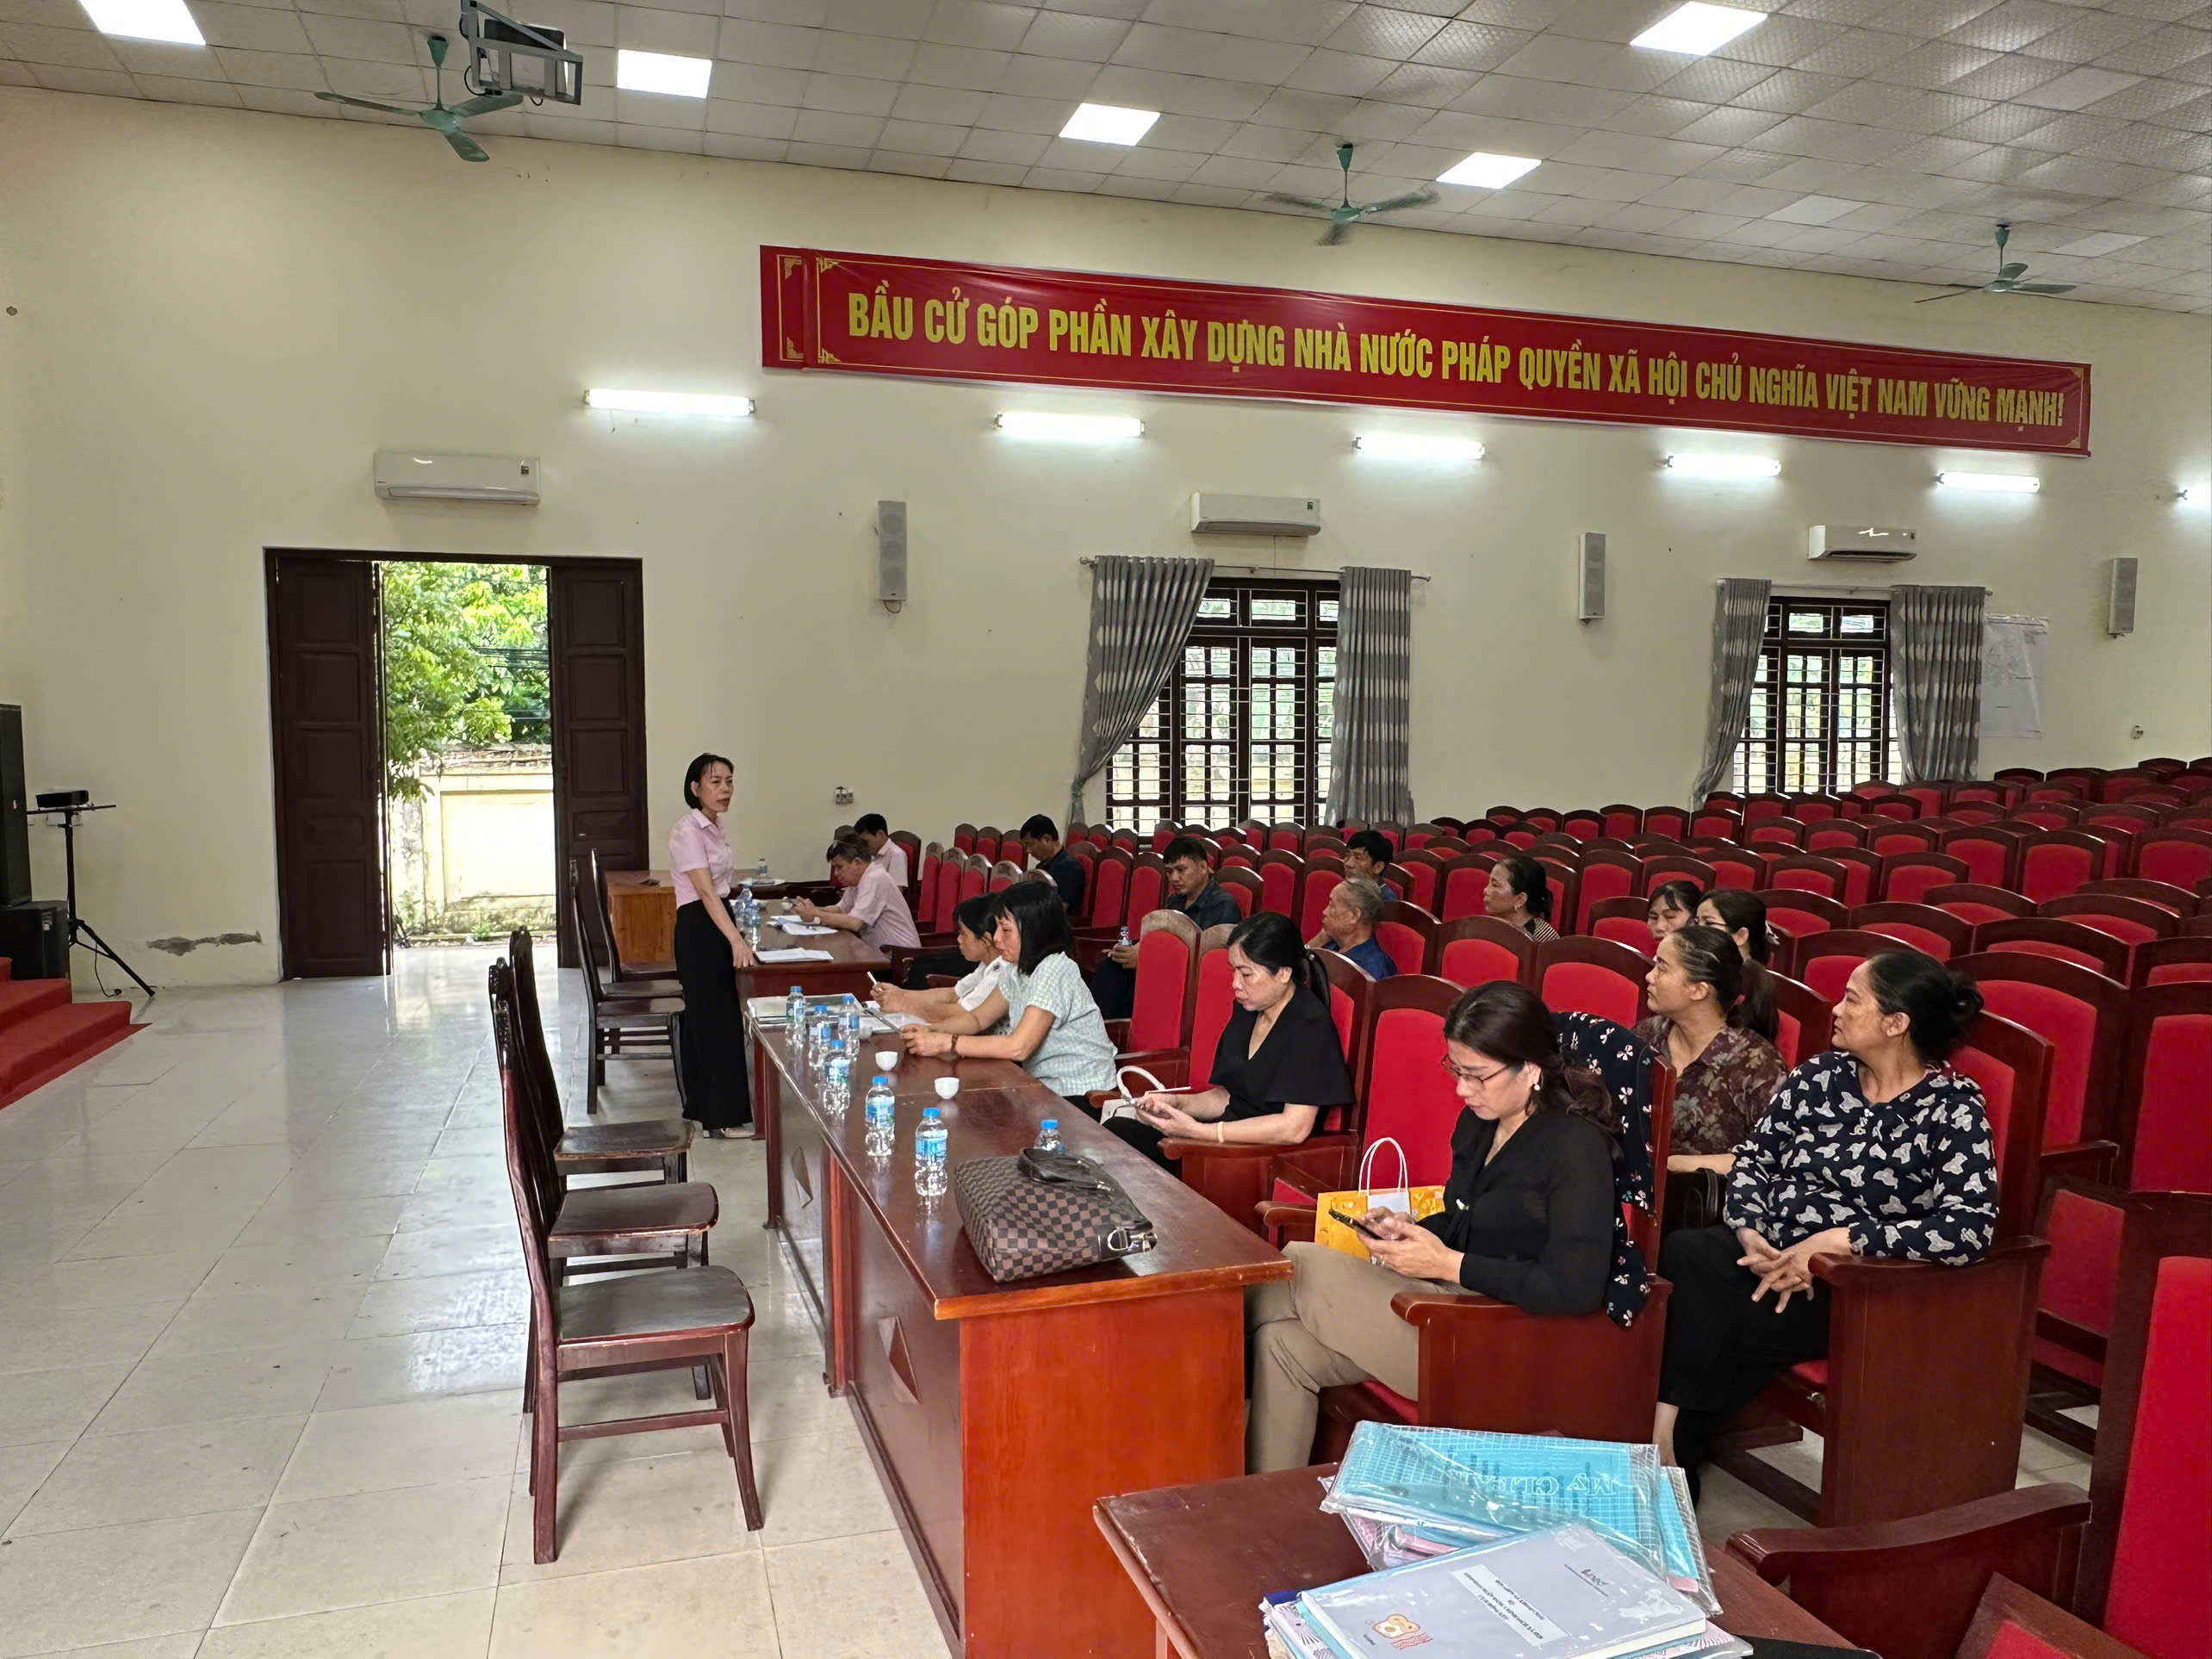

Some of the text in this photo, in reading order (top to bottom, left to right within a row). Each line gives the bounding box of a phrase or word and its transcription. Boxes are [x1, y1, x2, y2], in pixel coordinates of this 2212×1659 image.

[848, 279, 2065, 431] BẦU CỬ GÓP PHẦN XÂY DỰNG NHÀ NƯỚC PHÁP QUYỀN XÃ HỘI CHỦ NGHĨA VIỆT NAM VỮNG MẠNH!
